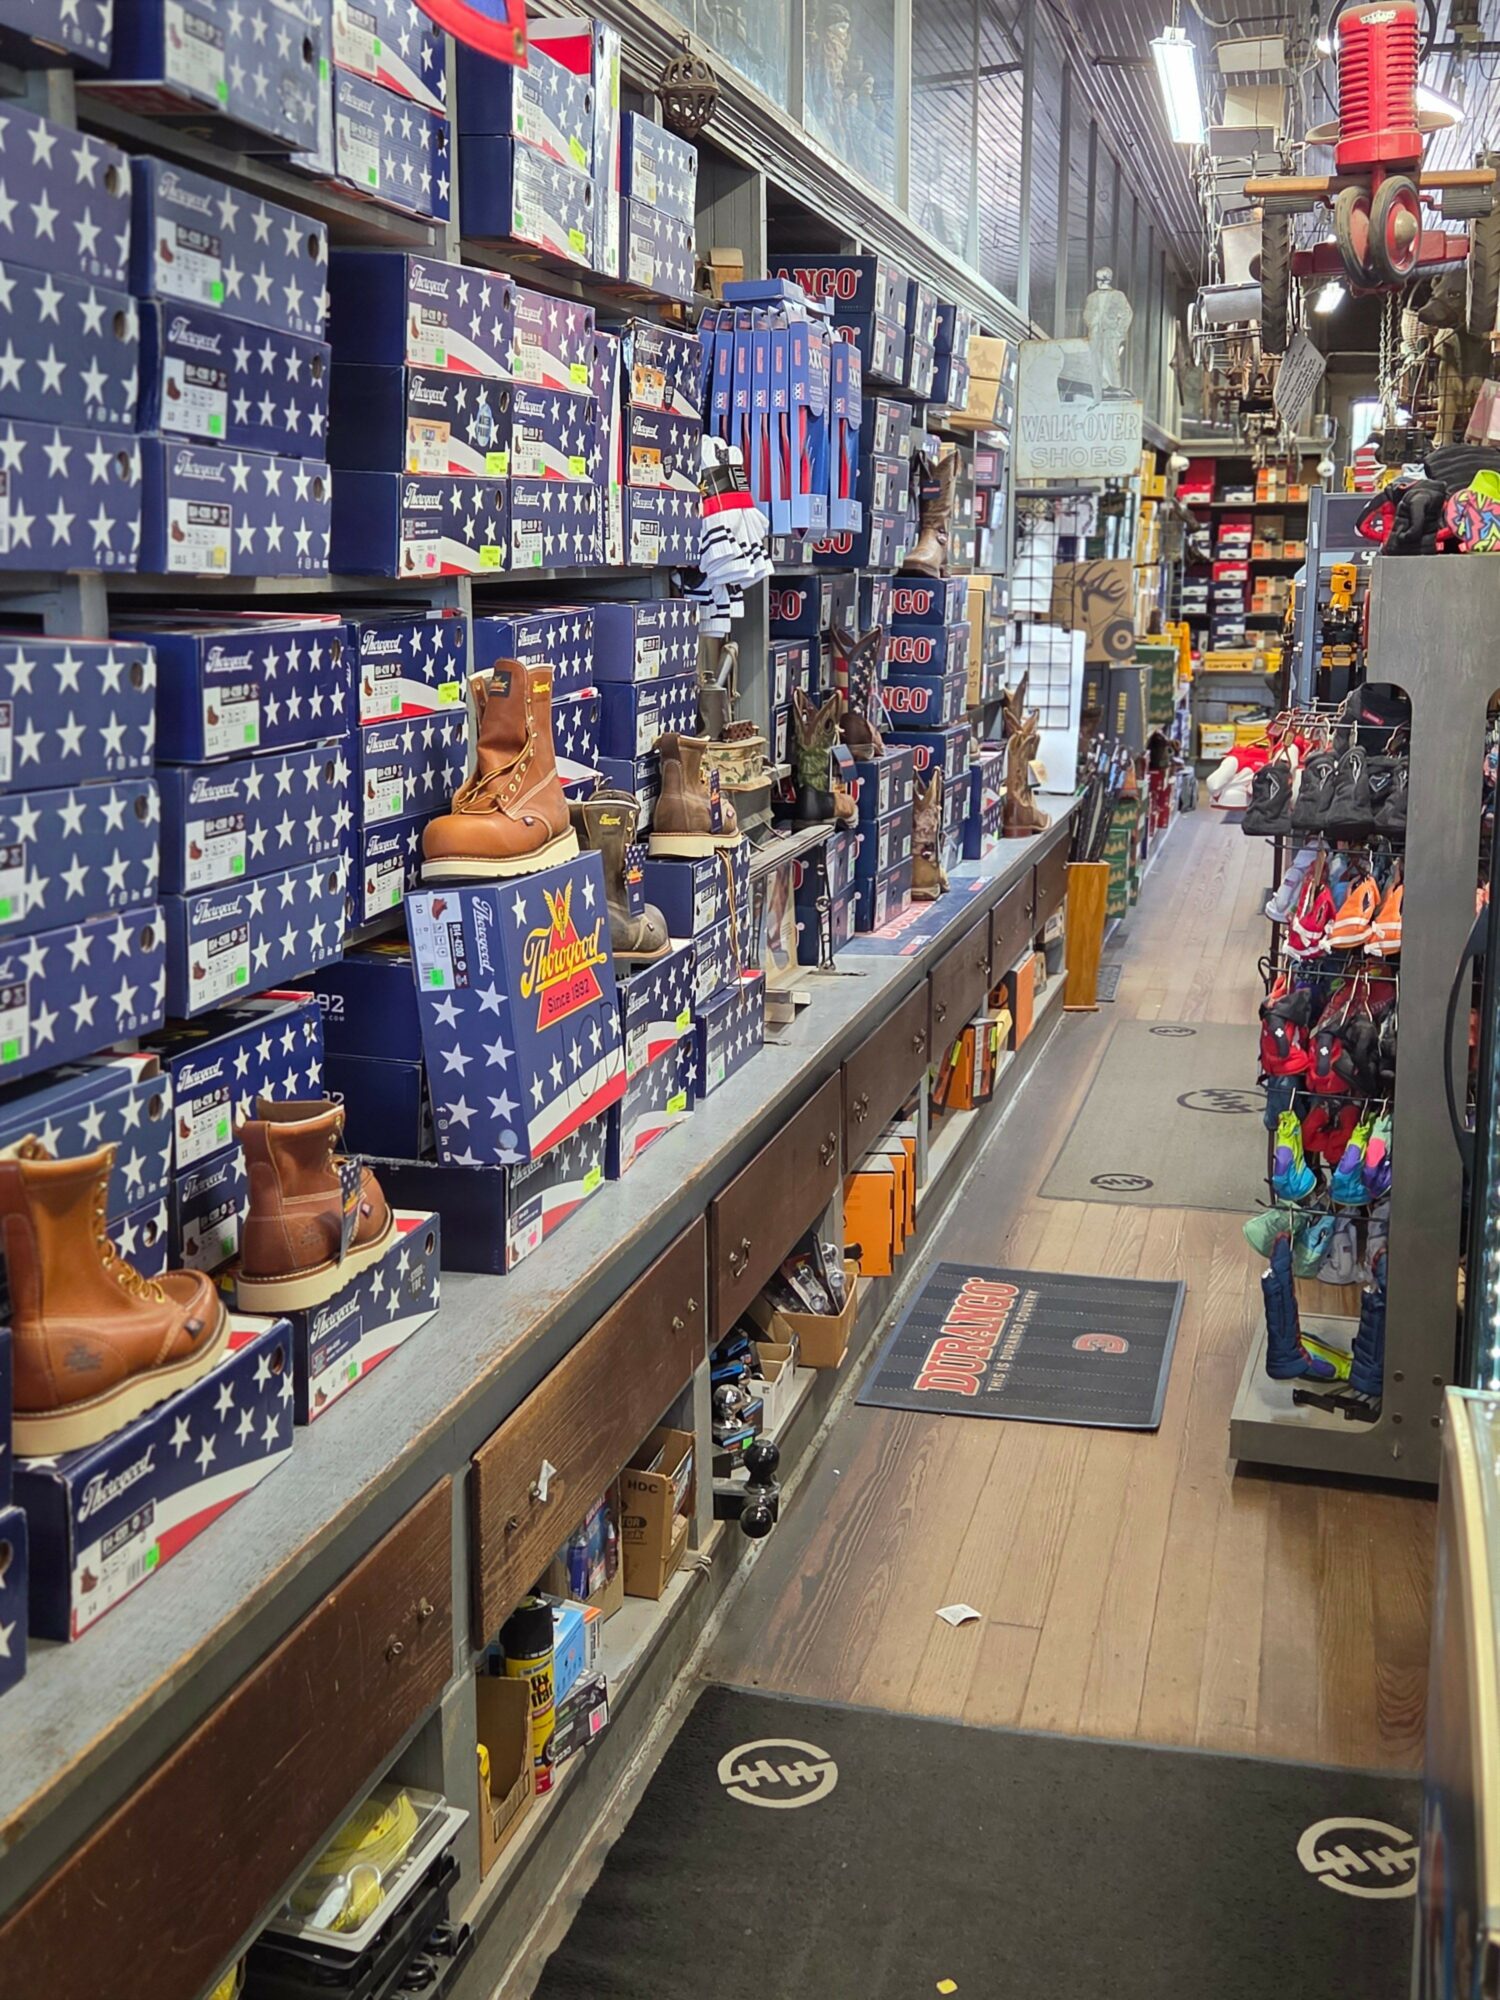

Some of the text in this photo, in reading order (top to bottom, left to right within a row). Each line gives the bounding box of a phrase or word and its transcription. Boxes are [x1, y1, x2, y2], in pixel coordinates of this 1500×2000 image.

[409, 264, 449, 300] Thorogood
[409, 375, 448, 407] Thorogood
[1030, 445, 1128, 469] SHOES
[403, 482, 443, 511] Thorogood
[361, 629, 402, 656] Thorogood
[205, 646, 254, 673] Thorogood
[366, 732, 399, 754] Thorogood
[189, 776, 240, 803] Thorogood
[366, 830, 400, 857] Thorogood
[192, 895, 243, 925] Thorogood
[472, 896, 495, 976] Thorogood
[520, 917, 608, 999] Thorogood
[547, 979, 590, 1013] Since 1892
[177, 1057, 224, 1093] Thorogood
[182, 1164, 227, 1202] Thorogood
[310, 1289, 361, 1344] Thorogood
[913, 1279, 1020, 1396] DURANGO
[987, 1289, 1040, 1392] THIS IS DURANGO COUNTRY
[77, 1444, 155, 1522] Thorogood
[627, 1480, 659, 1494] HDC
